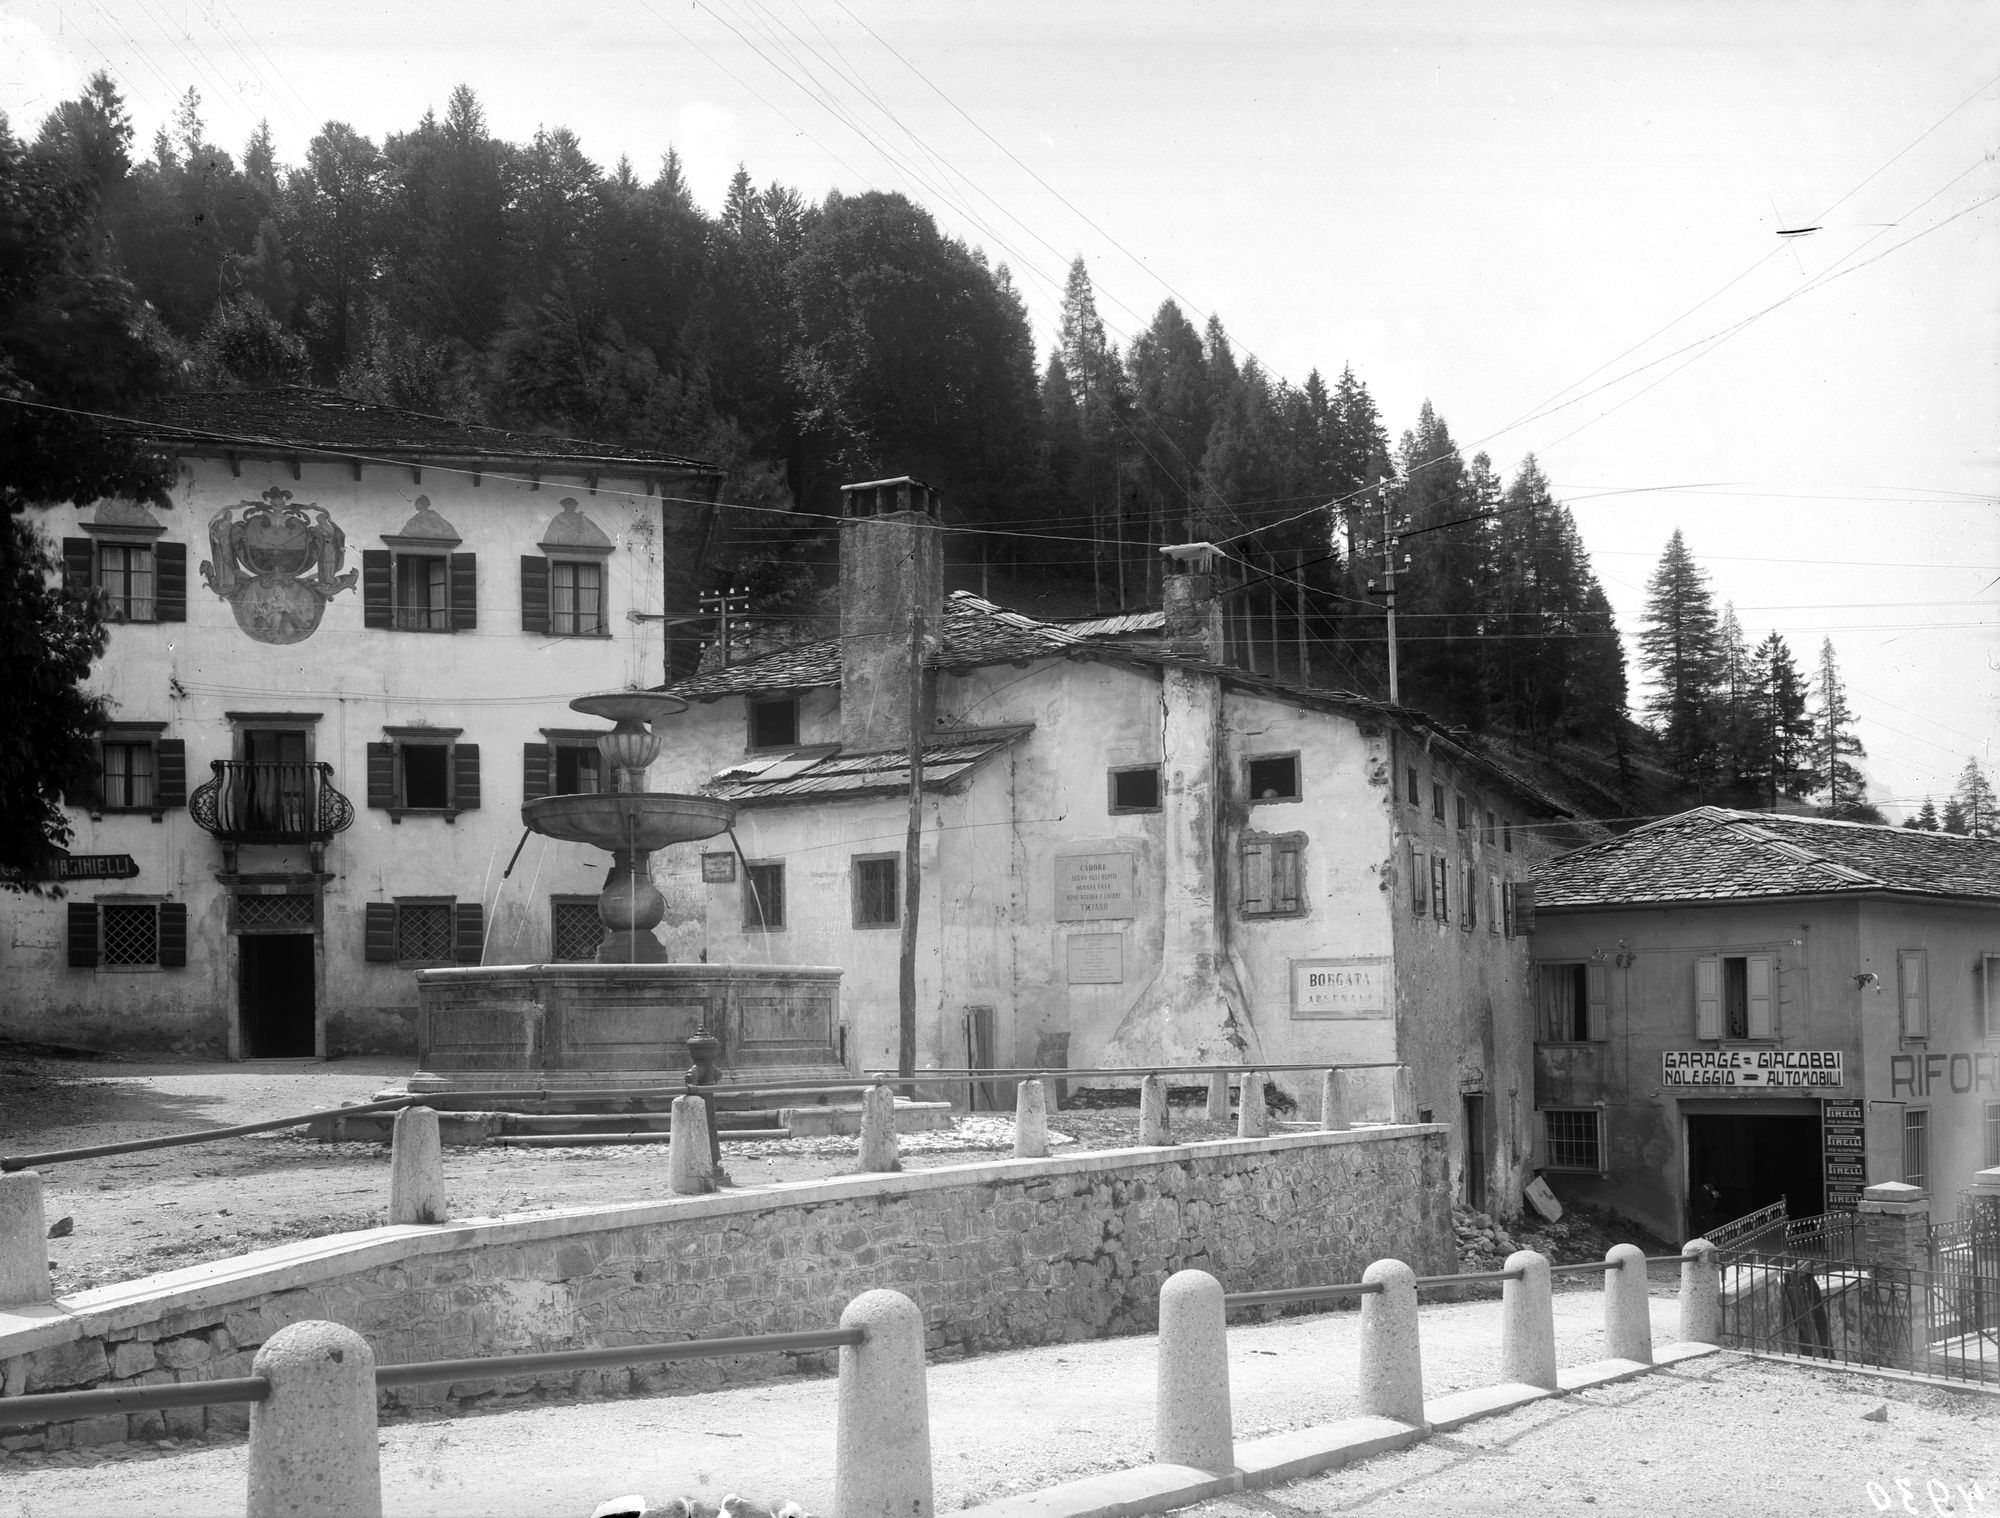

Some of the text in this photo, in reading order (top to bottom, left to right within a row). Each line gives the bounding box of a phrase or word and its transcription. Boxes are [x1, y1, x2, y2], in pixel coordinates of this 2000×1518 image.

[1309, 973, 1370, 987] BORGATA
[1664, 1052, 1841, 1069] GARAGE GIACOBBI
[1664, 1070, 1841, 1086] NOLEGGIO AUTOMOBILI
[1826, 1106, 1861, 1118] PIRELLI
[1827, 1134, 1862, 1146] PIRELLI
[1828, 1163, 1863, 1175] PIRELLI
